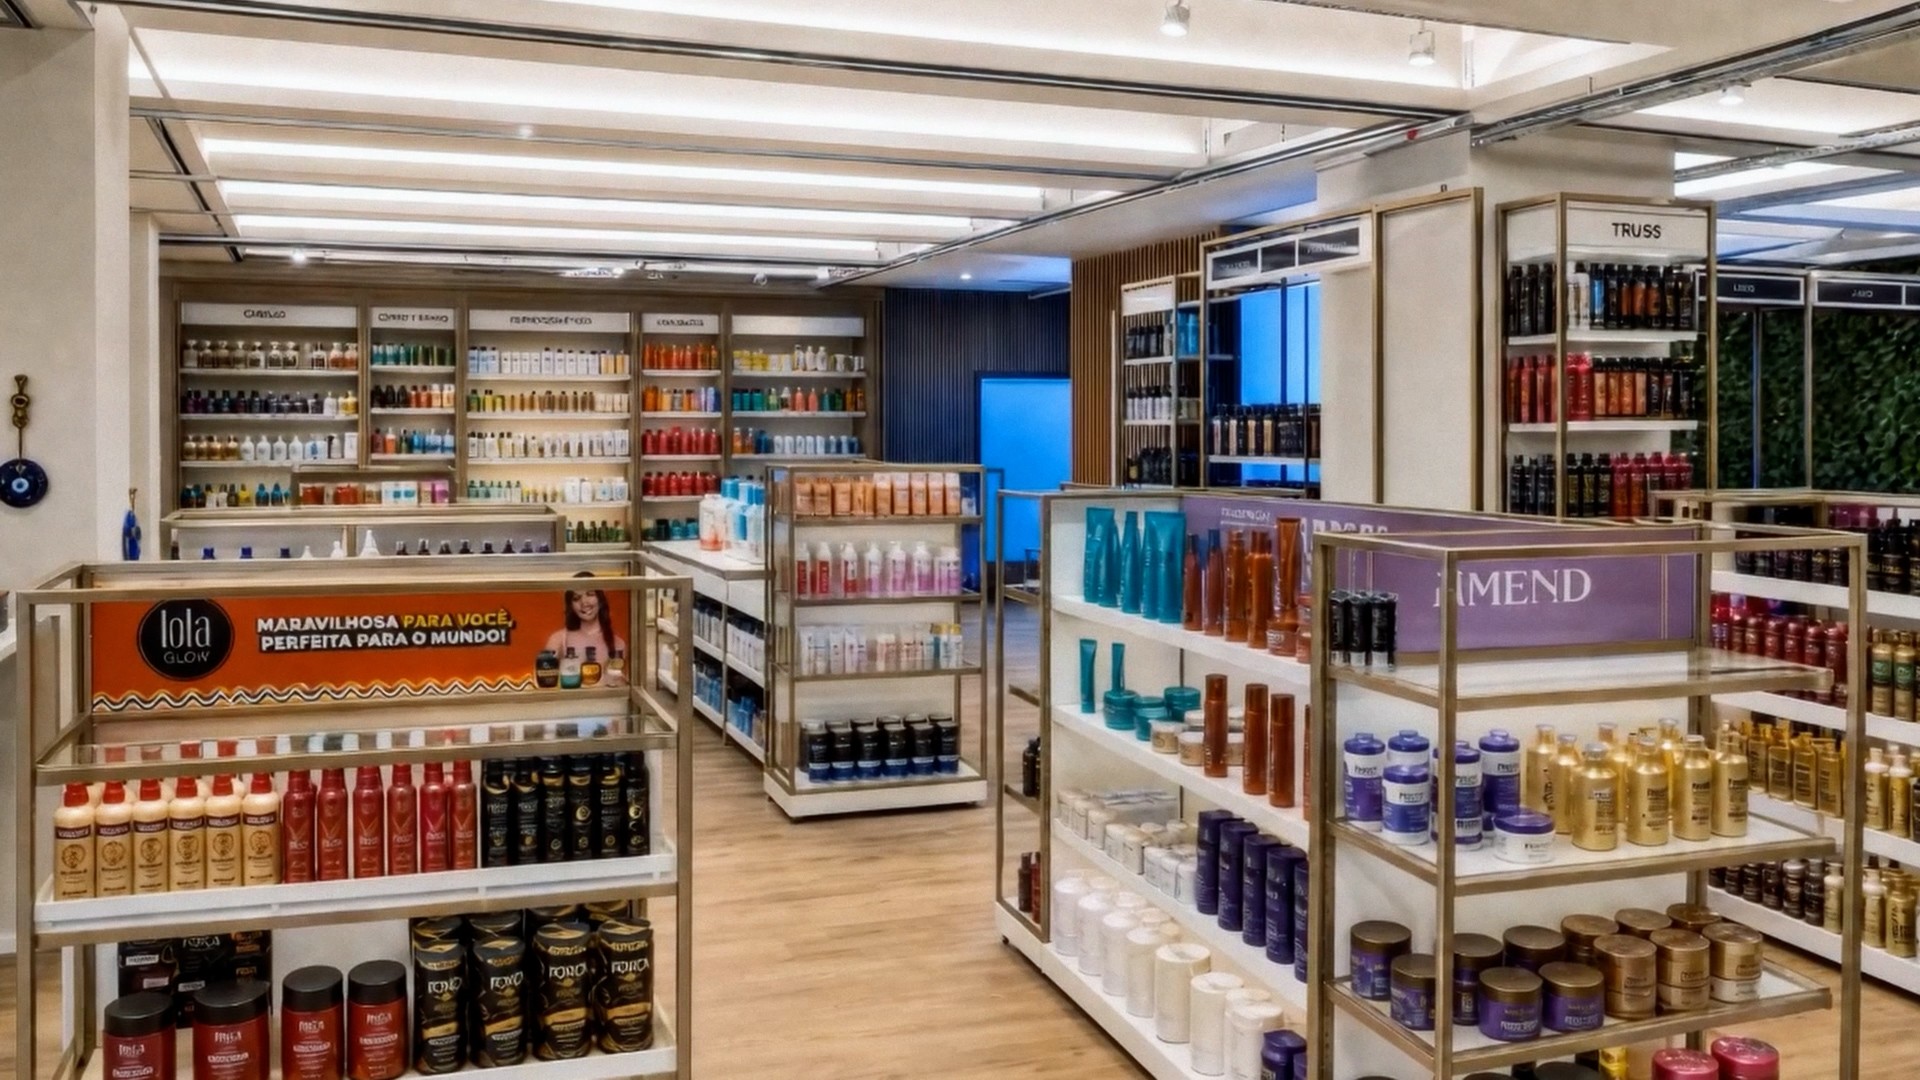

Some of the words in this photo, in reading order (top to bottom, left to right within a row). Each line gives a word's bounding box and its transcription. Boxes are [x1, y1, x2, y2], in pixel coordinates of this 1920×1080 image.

[1611, 222, 1662, 239] TRUSS
[161, 608, 211, 649] lola
[257, 614, 399, 633] MARAVILHOSA
[403, 614, 453, 629] PARA
[457, 608, 514, 628] VOCÊ,
[261, 633, 352, 651] PERFEITA
[357, 632, 409, 648] PARA
[411, 632, 426, 645] O
[430, 629, 507, 645] MUNDO!
[163, 650, 210, 664] GLOW
